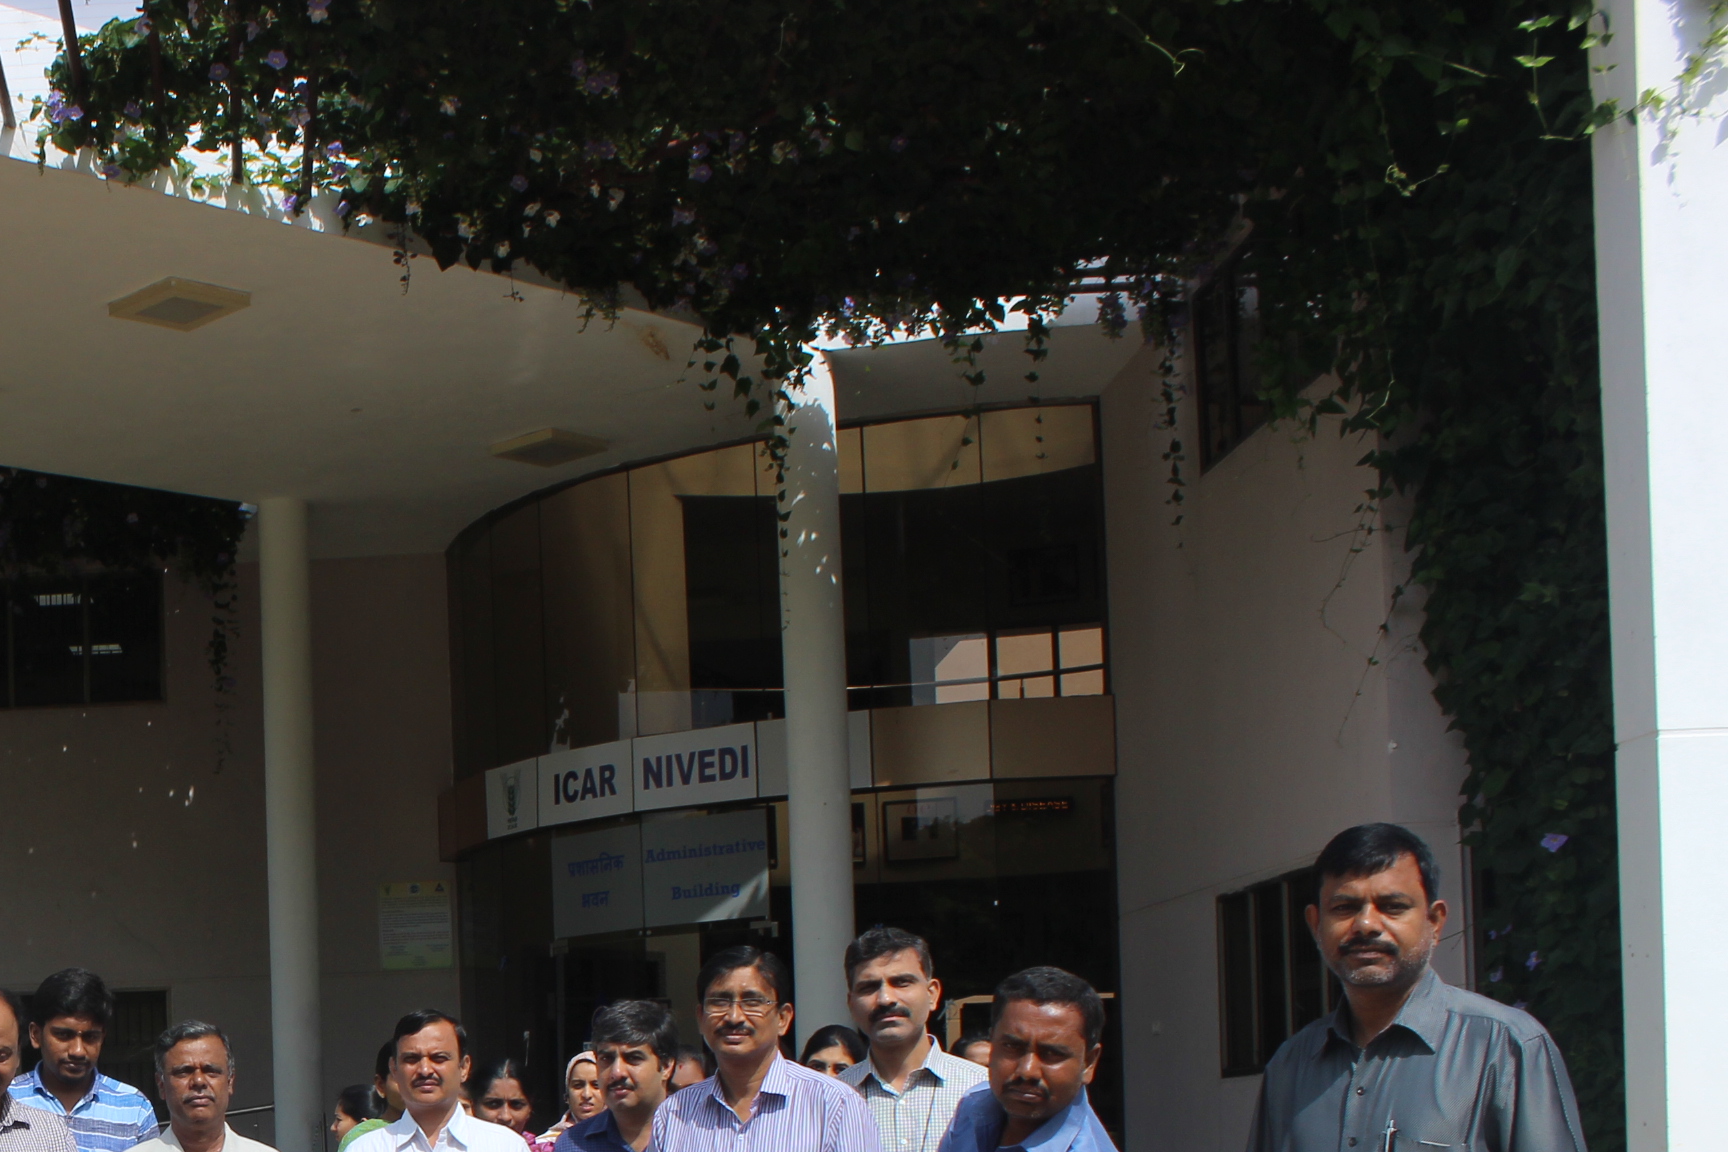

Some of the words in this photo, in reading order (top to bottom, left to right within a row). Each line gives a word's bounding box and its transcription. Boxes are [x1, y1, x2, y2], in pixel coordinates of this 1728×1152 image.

[554, 763, 617, 806] ICAR
[643, 744, 749, 791] NIVEDI
[644, 839, 766, 863] Administrative
[672, 881, 741, 900] Building
